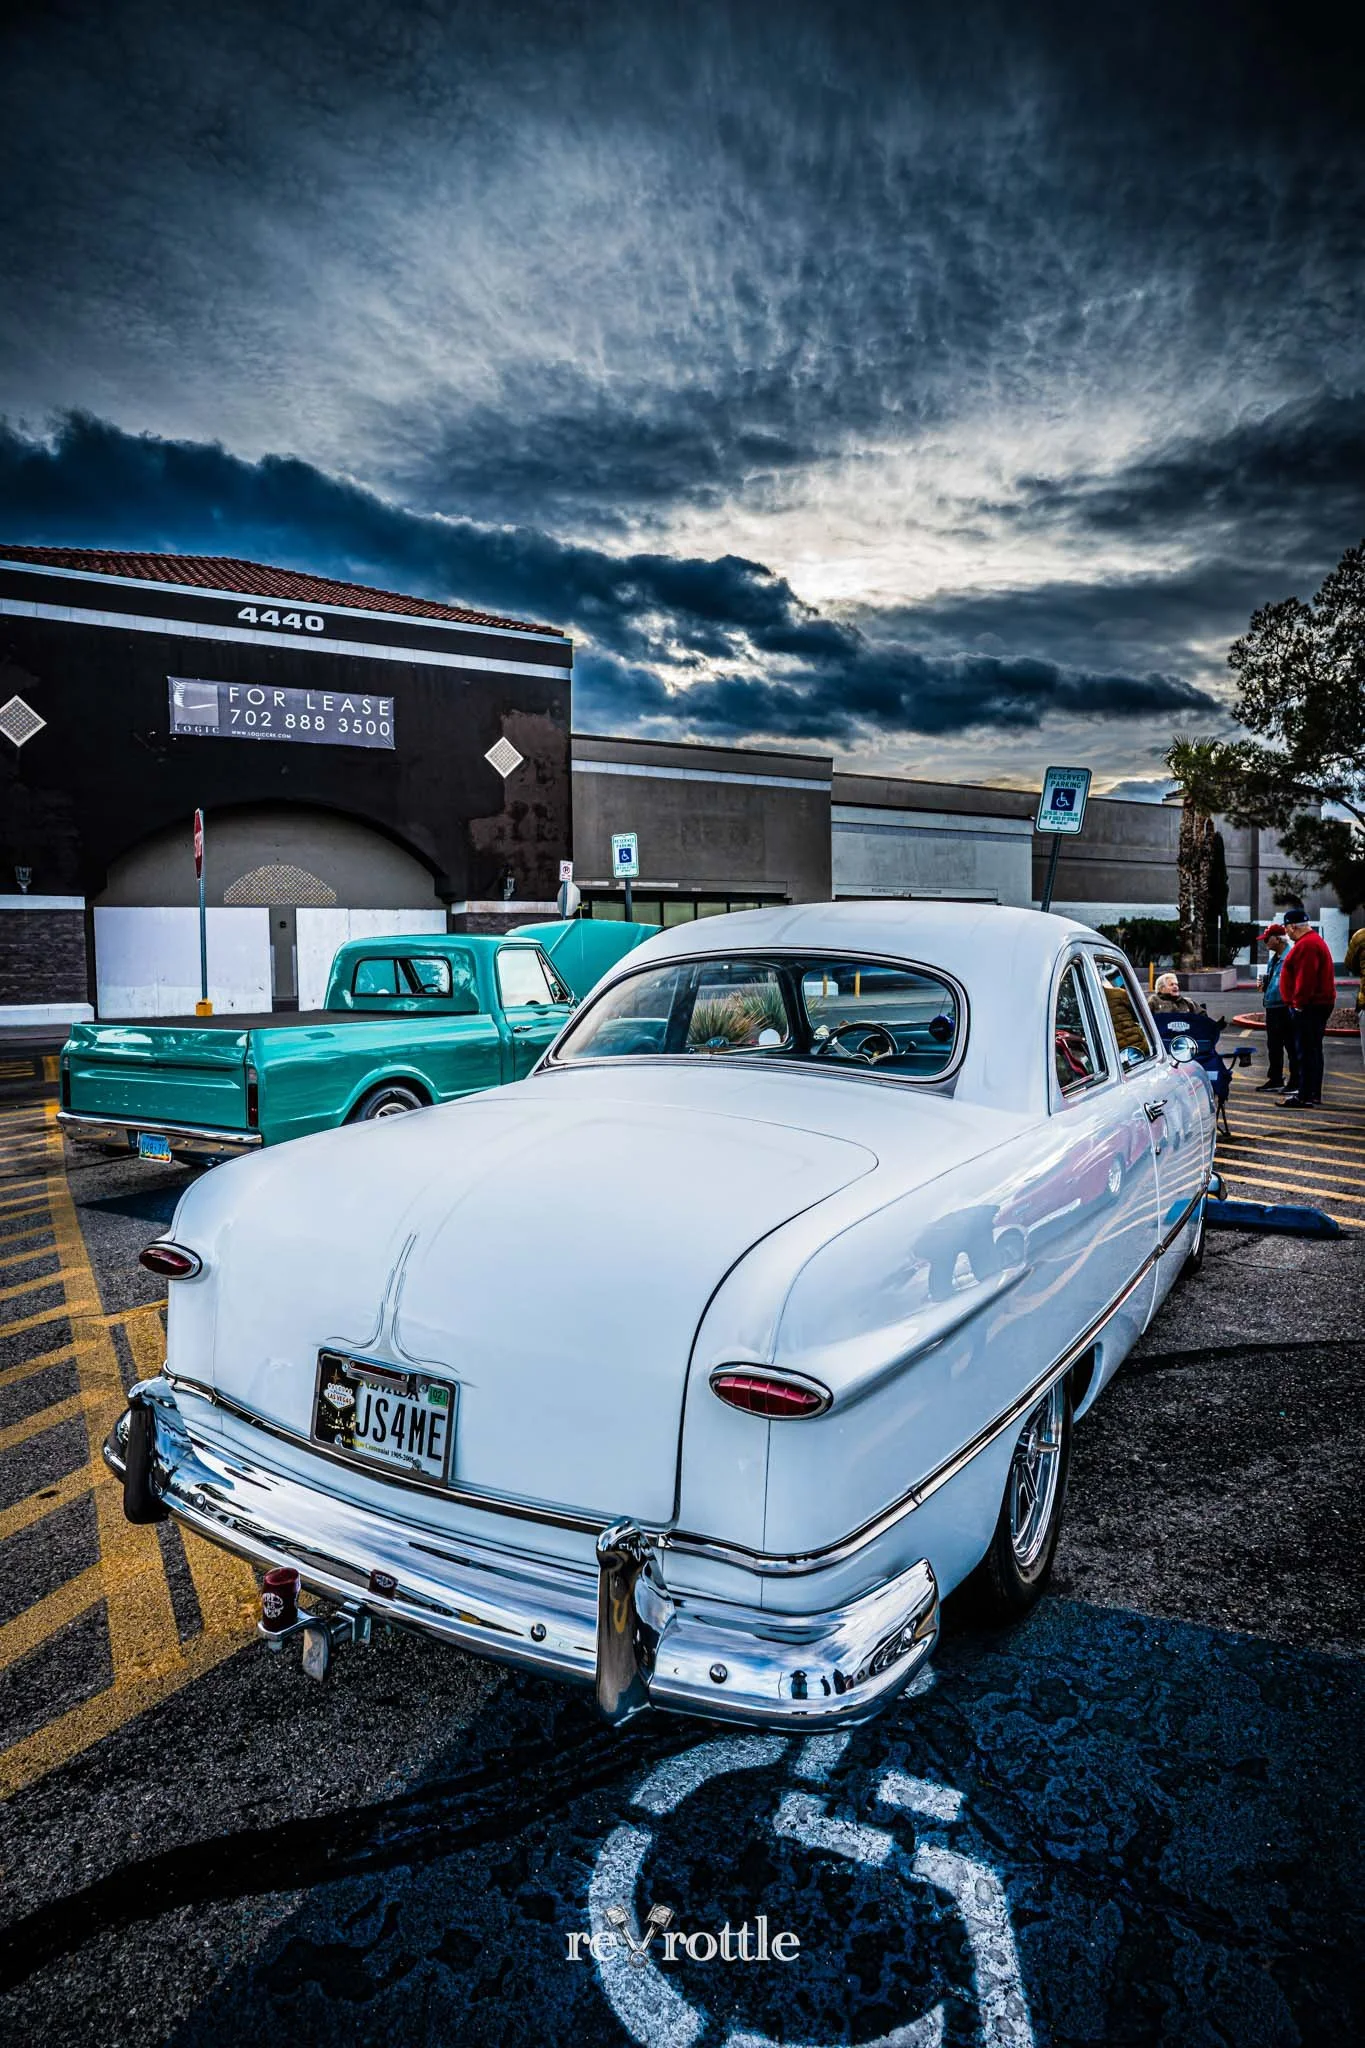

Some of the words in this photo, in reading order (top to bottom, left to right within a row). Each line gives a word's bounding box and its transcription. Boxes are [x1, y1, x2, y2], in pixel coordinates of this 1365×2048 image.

[237, 606, 325, 632] 4440
[228, 686, 286, 708] FOR
[306, 692, 390, 717] LEASE
[174, 724, 220, 735] LOGIC
[230, 709, 273, 727] 702
[284, 713, 326, 731] 888
[337, 718, 391, 737] 3500
[1048, 772, 1086, 782] RESERVED
[1050, 780, 1082, 789] PARKING
[336, 1395, 353, 1404] VEGAS
[355, 1394, 446, 1462] JS4ME
[365, 1443, 390, 1456] Centennial
